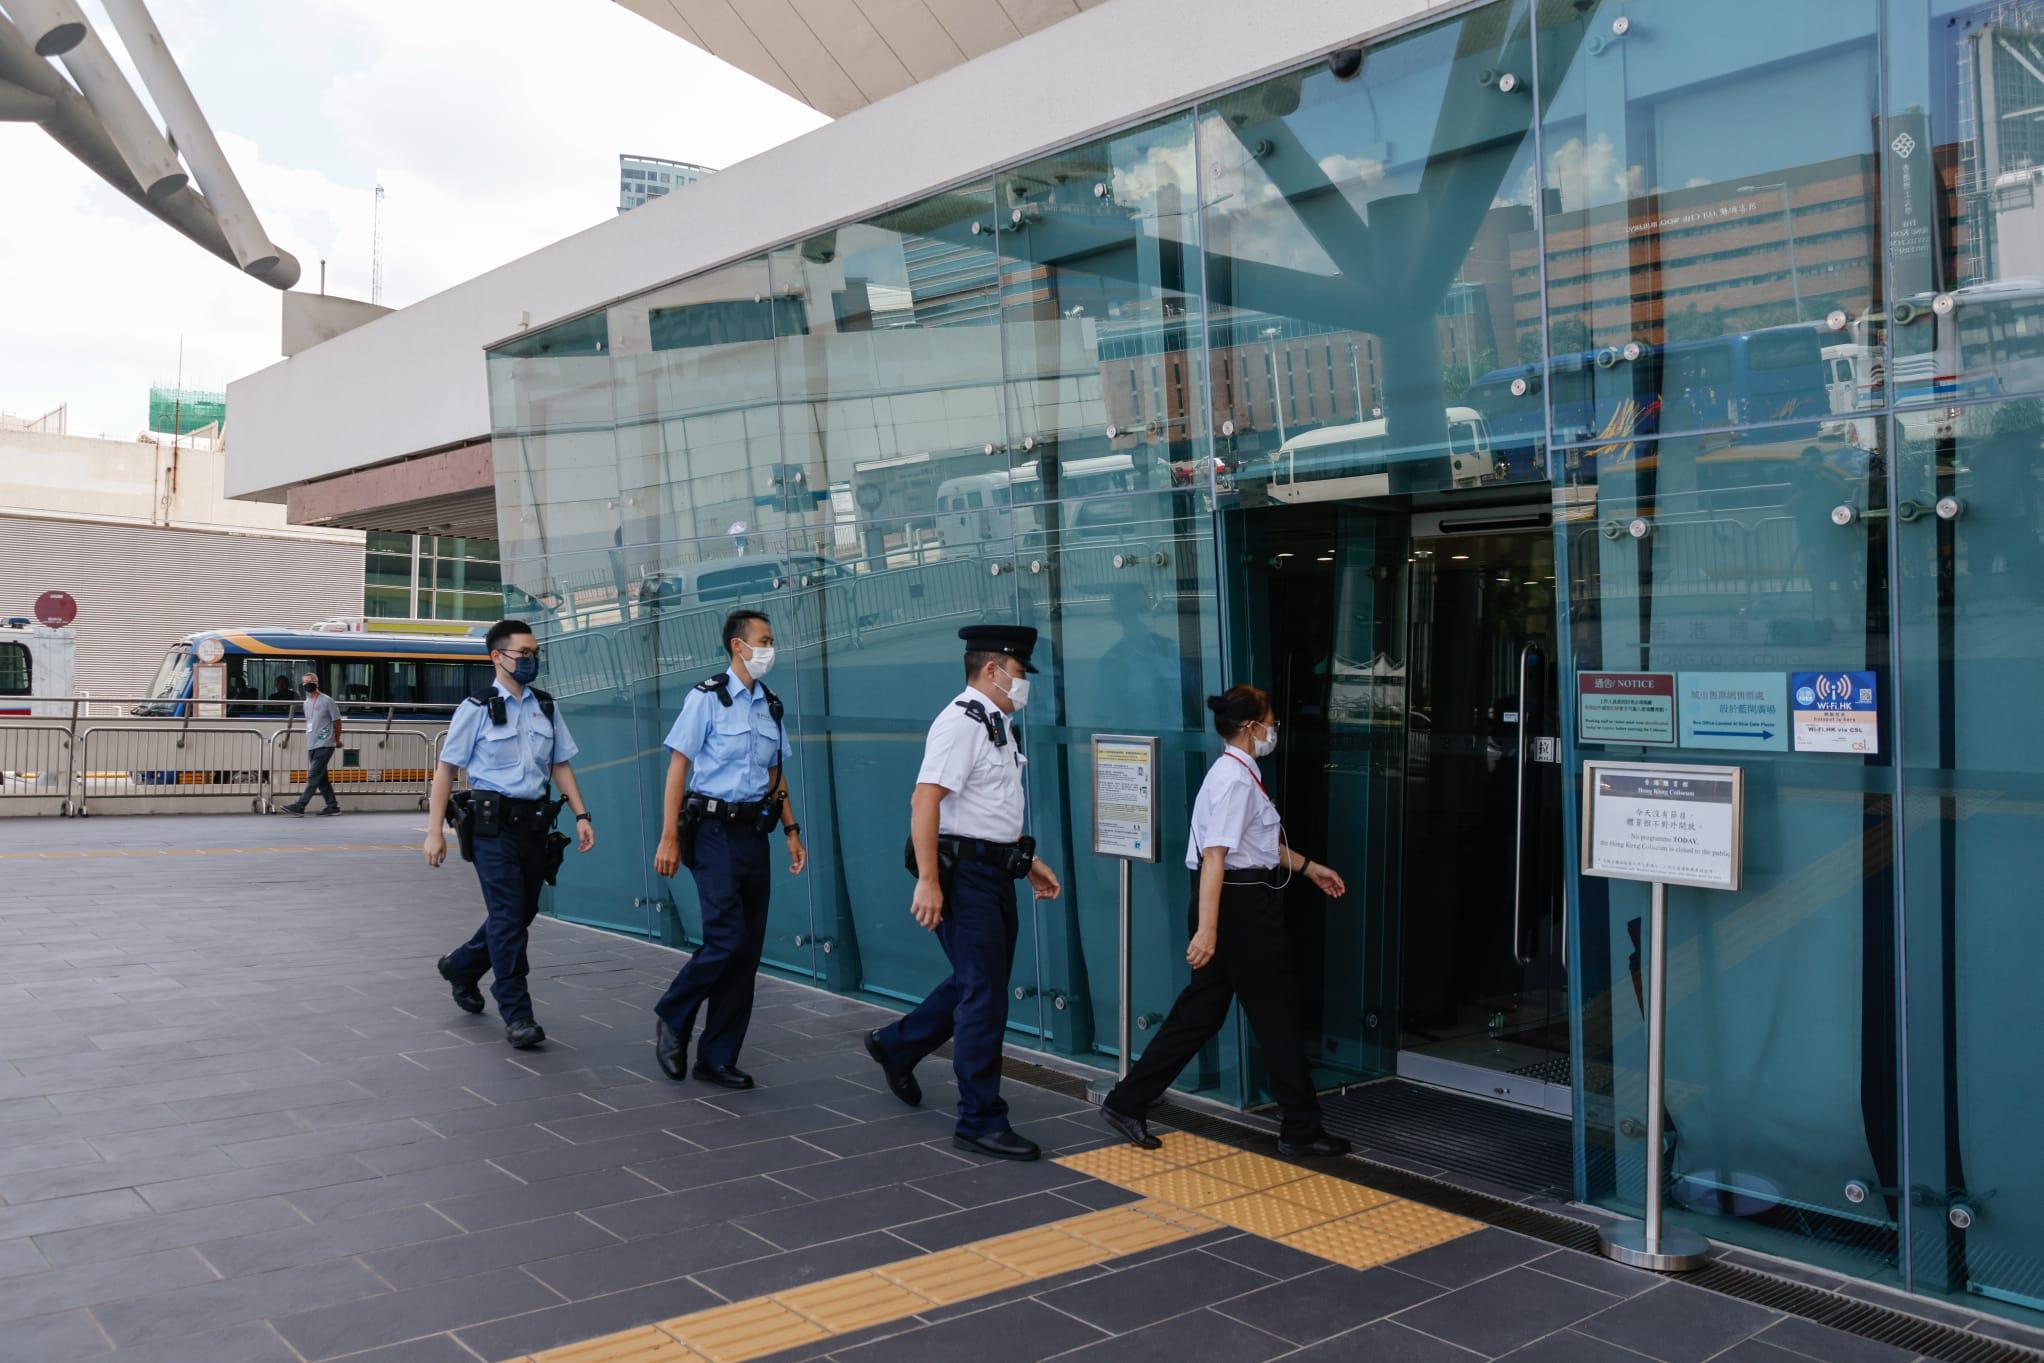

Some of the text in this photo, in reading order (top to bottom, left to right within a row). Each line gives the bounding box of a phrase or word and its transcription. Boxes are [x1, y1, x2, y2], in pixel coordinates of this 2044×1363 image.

[1617, 679, 1656, 689] NOTICE
[1638, 786, 1653, 796] Hong
[1675, 846, 1694, 854] closed
